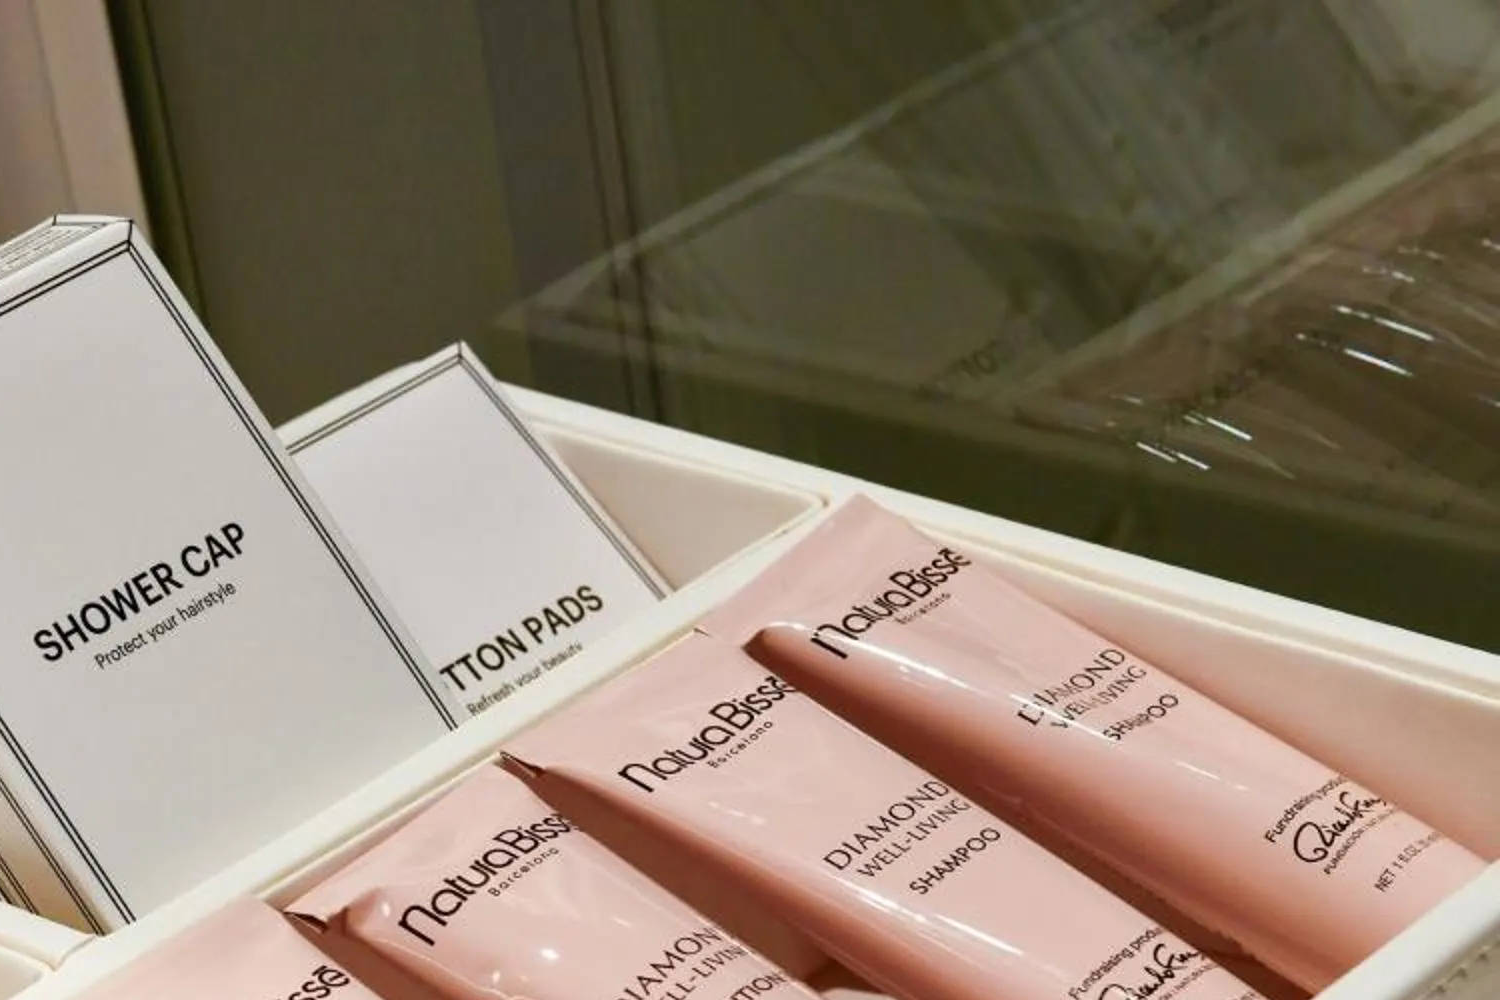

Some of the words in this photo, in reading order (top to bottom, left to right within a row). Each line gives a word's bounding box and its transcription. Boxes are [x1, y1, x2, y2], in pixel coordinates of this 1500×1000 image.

[33, 562, 184, 662] SHOWER
[180, 522, 245, 577] CAP
[94, 632, 146, 669] Protect
[146, 616, 180, 642] your
[176, 581, 237, 622] hairstyle
[439, 629, 528, 691] TTON
[521, 585, 603, 644] PADS
[465, 682, 516, 716] Refresh
[823, 781, 950, 871] DIAMOND
[856, 798, 972, 878] WELL-LIVING
[909, 827, 1001, 895] SHAMPOO
[487, 847, 560, 897] Barcelona
